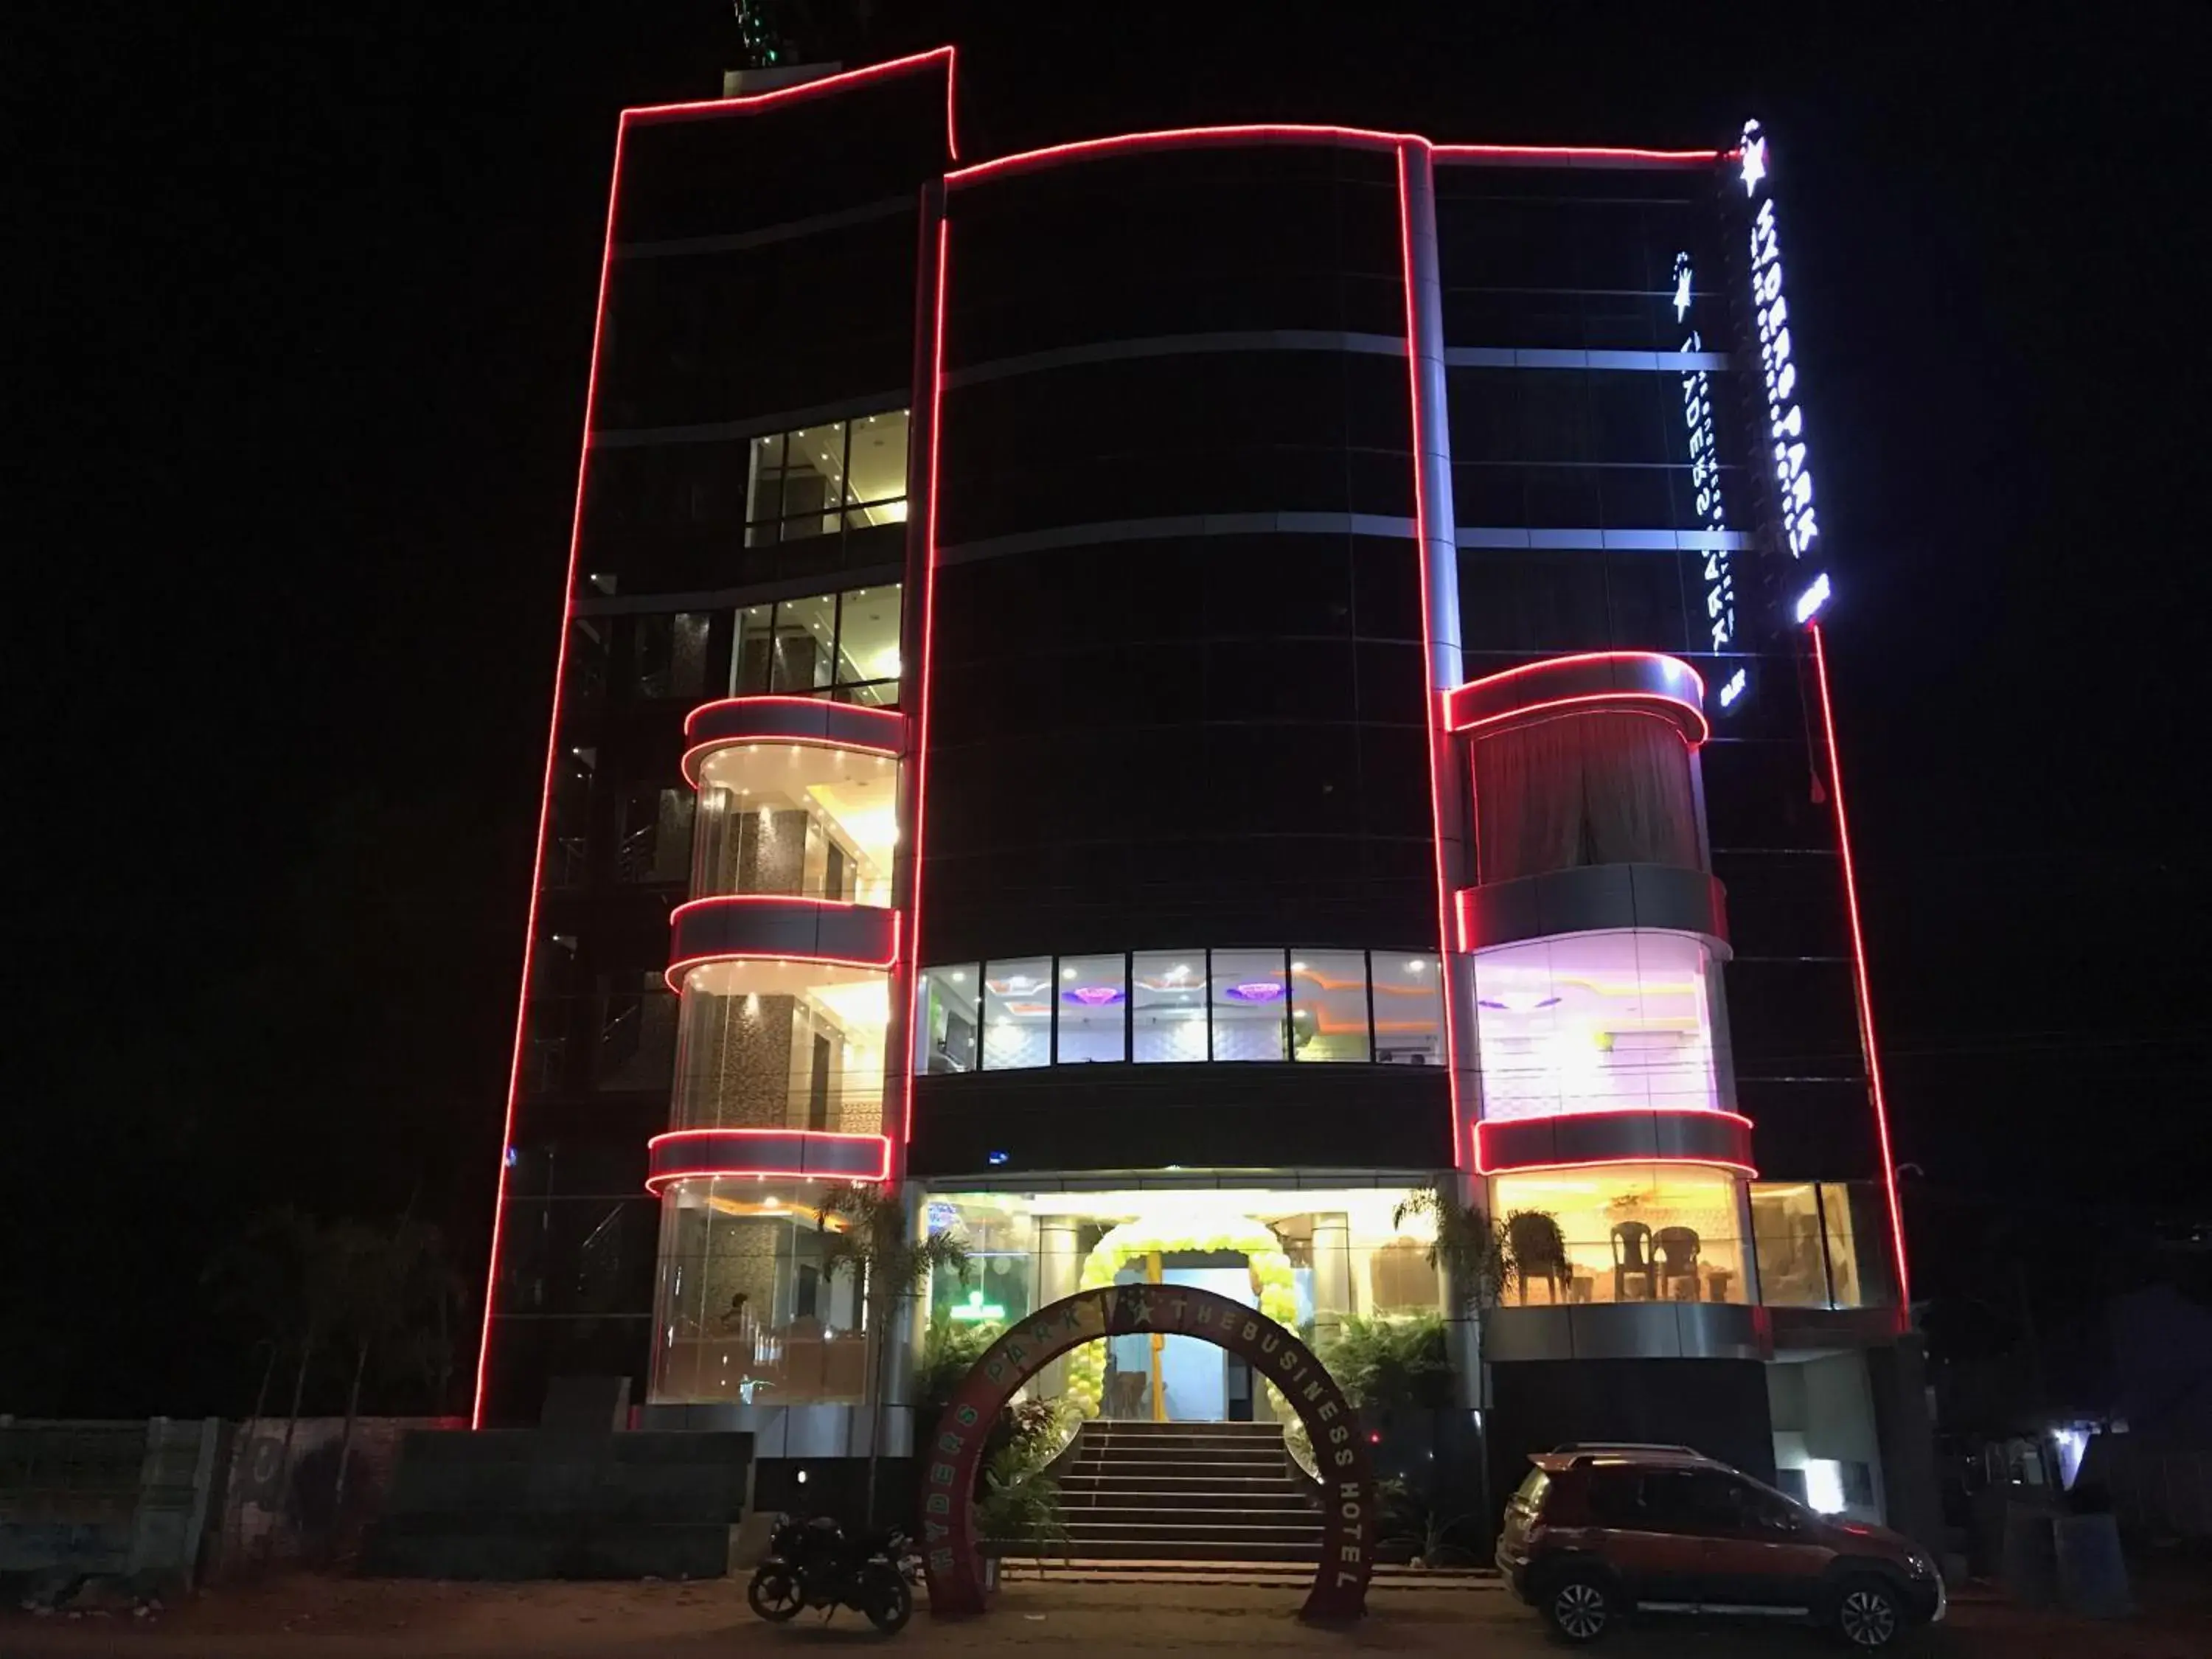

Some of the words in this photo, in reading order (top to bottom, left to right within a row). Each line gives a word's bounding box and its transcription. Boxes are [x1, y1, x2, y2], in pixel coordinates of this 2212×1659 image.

[925, 1404, 979, 1573] HYDERS
[984, 1305, 1082, 1385] PARK
[1335, 1481, 1362, 1588] HOTEL
